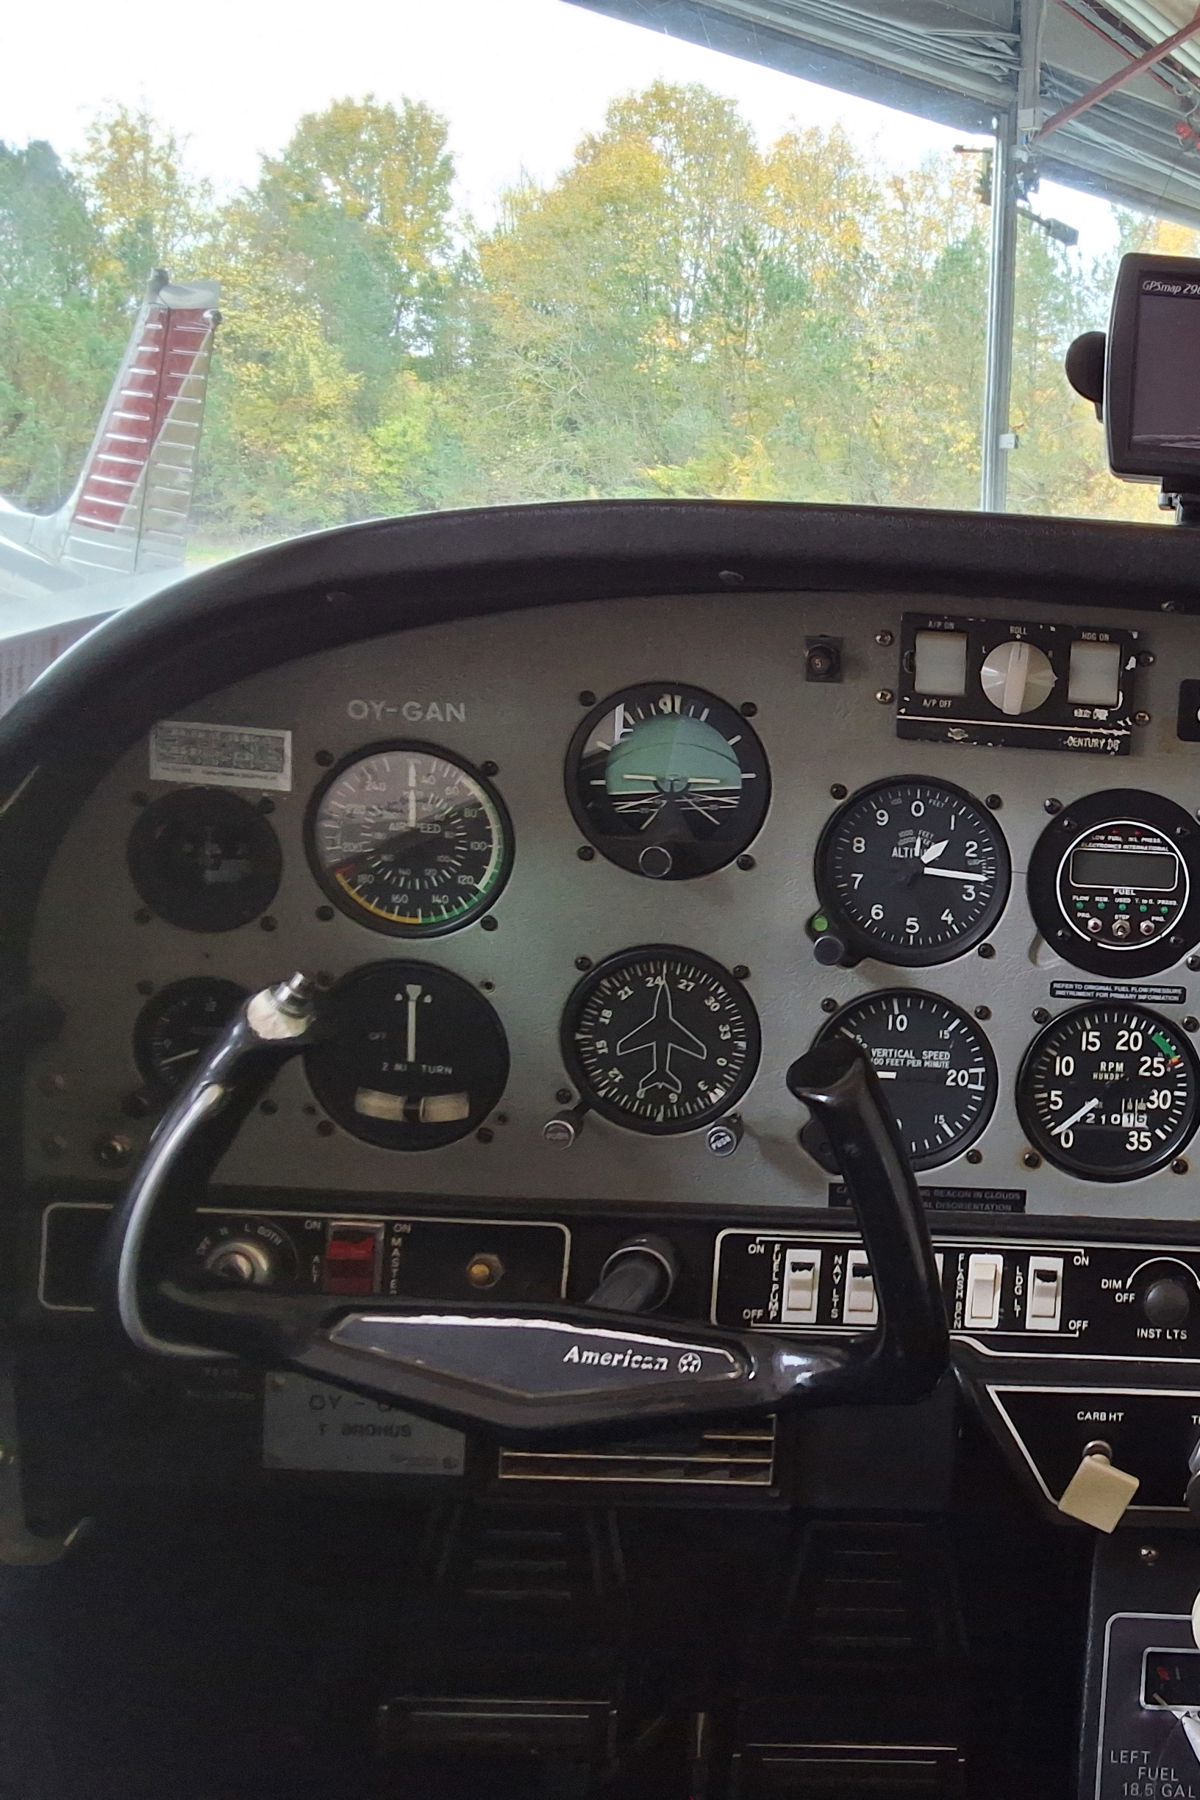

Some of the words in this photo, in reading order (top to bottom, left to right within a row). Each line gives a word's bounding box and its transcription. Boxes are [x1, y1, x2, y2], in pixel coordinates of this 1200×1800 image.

[1142, 280, 1182, 294] GPSmap
[1010, 625, 1027, 635] ROLL
[348, 699, 466, 723] OY-GAN
[923, 699, 938, 707] A/P
[940, 700, 952, 708] OFF
[875, 809, 889, 826] 9
[852, 836, 866, 853] 8
[851, 873, 864, 890] 7
[1113, 888, 1136, 896] FUEL
[870, 903, 884, 920] 6
[887, 1014, 908, 1032] 10
[1081, 1031, 1101, 1052] 15
[1115, 1031, 1143, 1052] 20
[871, 1048, 915, 1060] VERTICAL
[922, 1050, 950, 1060] SPEED
[421, 1064, 452, 1075] TURN
[885, 1058, 905, 1067] FEET
[924, 1060, 950, 1069] MINUTE
[1055, 1055, 1075, 1076] 10
[1100, 1061, 1124, 1072] RPM
[1138, 1056, 1165, 1077] 25
[945, 1069, 969, 1087] 20
[1049, 1090, 1063, 1110] 5
[1146, 1089, 1172, 1110] 30
[1061, 1131, 1074, 1149] 0
[1125, 1131, 1152, 1152] 35
[933, 1189, 971, 1199] BEACON
[984, 1192, 1021, 1200] CLOUDS
[935, 1202, 1012, 1212] DISORIENTATION
[304, 1220, 321, 1230] ON
[257, 1225, 282, 1246] BOTH
[748, 1243, 765, 1255] ON
[390, 1237, 403, 1294] MASTER
[772, 1244, 782, 1281] FUEL
[832, 1254, 843, 1285] NAV
[1073, 1256, 1089, 1266] ON
[955, 1253, 965, 1299] FLASH
[1014, 1265, 1024, 1295] LDG
[1101, 1278, 1122, 1291] DIM
[768, 1283, 780, 1320] PUMP
[830, 1288, 840, 1319] LTS
[1115, 1292, 1136, 1304] OFF
[743, 1308, 764, 1320] OFF
[953, 1301, 963, 1329] BCN
[1068, 1320, 1089, 1330] OFF
[1136, 1328, 1163, 1340] INST
[1166, 1329, 1188, 1341] LTS
[563, 1345, 669, 1371] American
[1077, 1410, 1107, 1421] CARB
[1107, 1412, 1125, 1423] HT
[1110, 1750, 1151, 1764] LEFT
[1138, 1767, 1179, 1782] FUEL
[1122, 1782, 1154, 1798] 18.5
[1161, 1783, 1196, 1799] GAL
